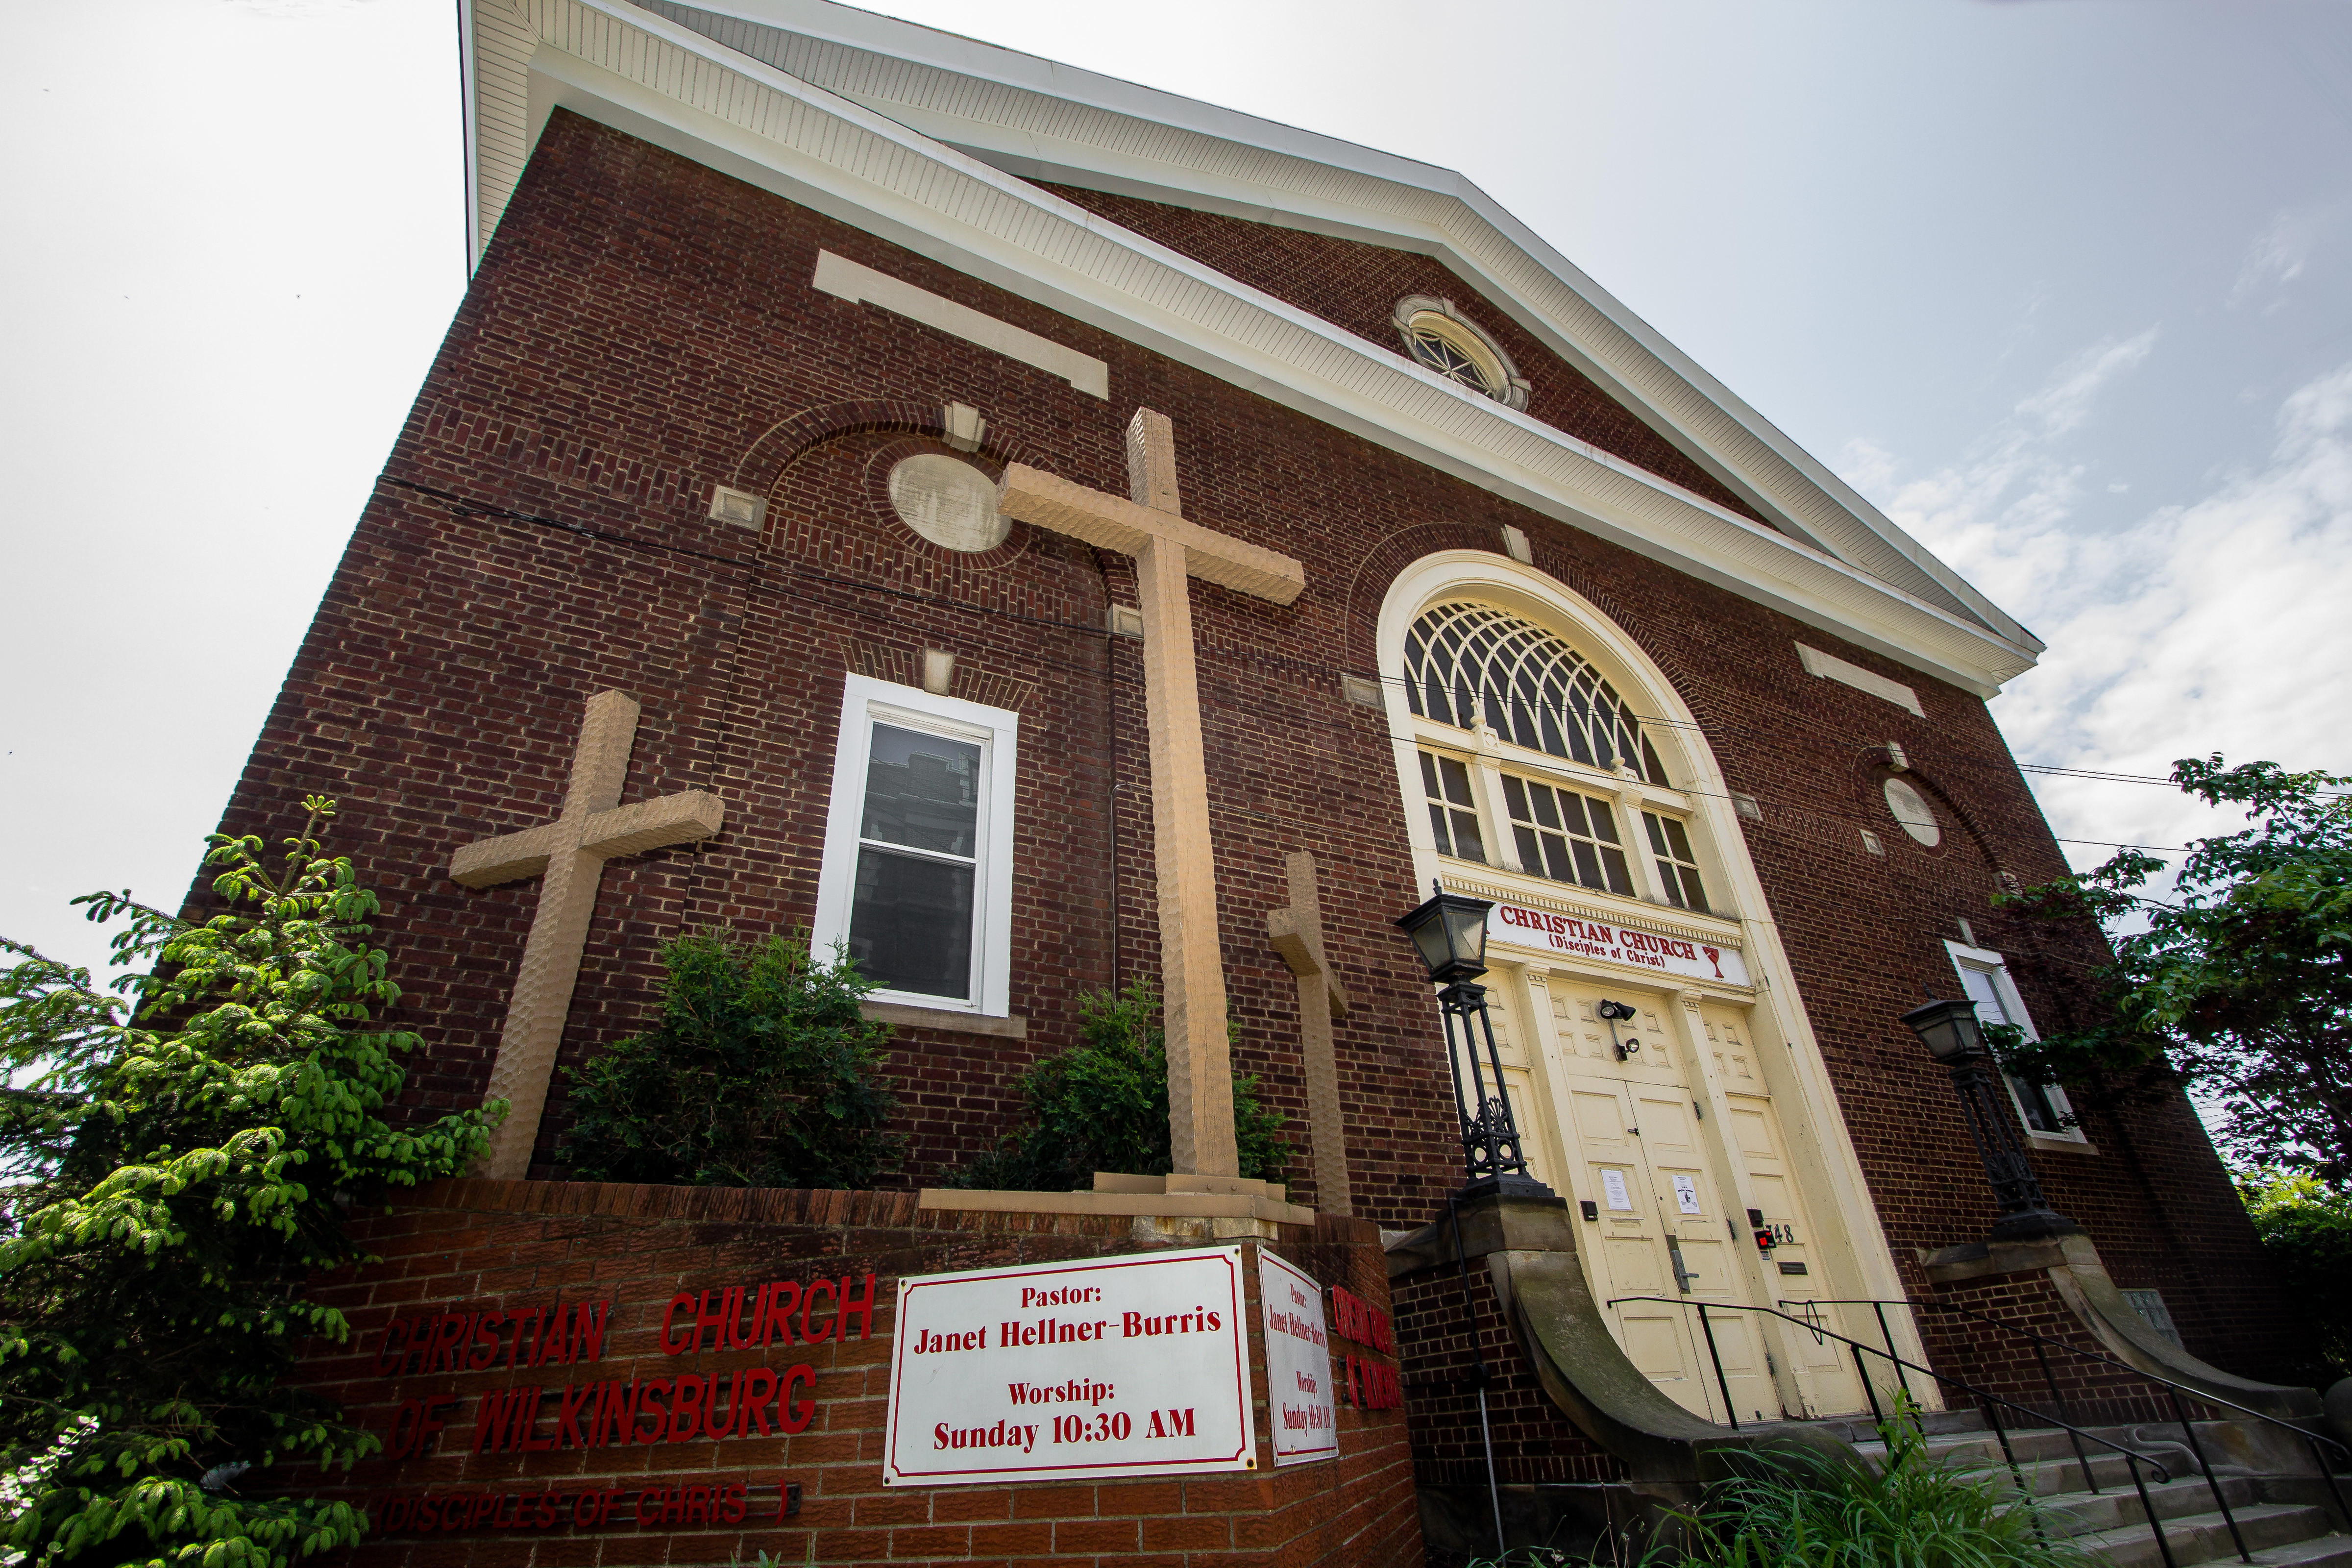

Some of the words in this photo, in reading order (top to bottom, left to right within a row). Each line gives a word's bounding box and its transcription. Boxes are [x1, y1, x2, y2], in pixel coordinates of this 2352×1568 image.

[1500, 906, 1614, 944] CHRISTIAN
[1620, 930, 1697, 960] CHURCH
[1549, 934, 1606, 956] (Disciples
[1611, 947, 1622, 959] of
[1627, 950, 1665, 968] Christ)
[1021, 1287, 1101, 1308] Pastor:
[1290, 1283, 1307, 1309] Pastor:
[372, 1300, 609, 1377] CHRISTIAN
[660, 1274, 876, 1355] CHURCH
[914, 1325, 986, 1354] Janet
[1001, 1306, 1221, 1347] Hellner-Burris
[1269, 1304, 1288, 1334] Janet
[1289, 1312, 1325, 1348] Hellner-Burris
[1008, 1378, 1114, 1406] Worship:
[1296, 1371, 1317, 1399] Worship:
[386, 1394, 456, 1460] OF
[473, 1365, 815, 1455] WILKINSBURG
[934, 1419, 1039, 1453] Sunday
[1053, 1412, 1131, 1444] 10:30
[1145, 1408, 1196, 1438] AM
[1283, 1402, 1308, 1437] Sunday
[1309, 1404, 1323, 1429] 10:30
[375, 1490, 561, 1536] (DISCIPLES
[574, 1488, 625, 1527] OF
